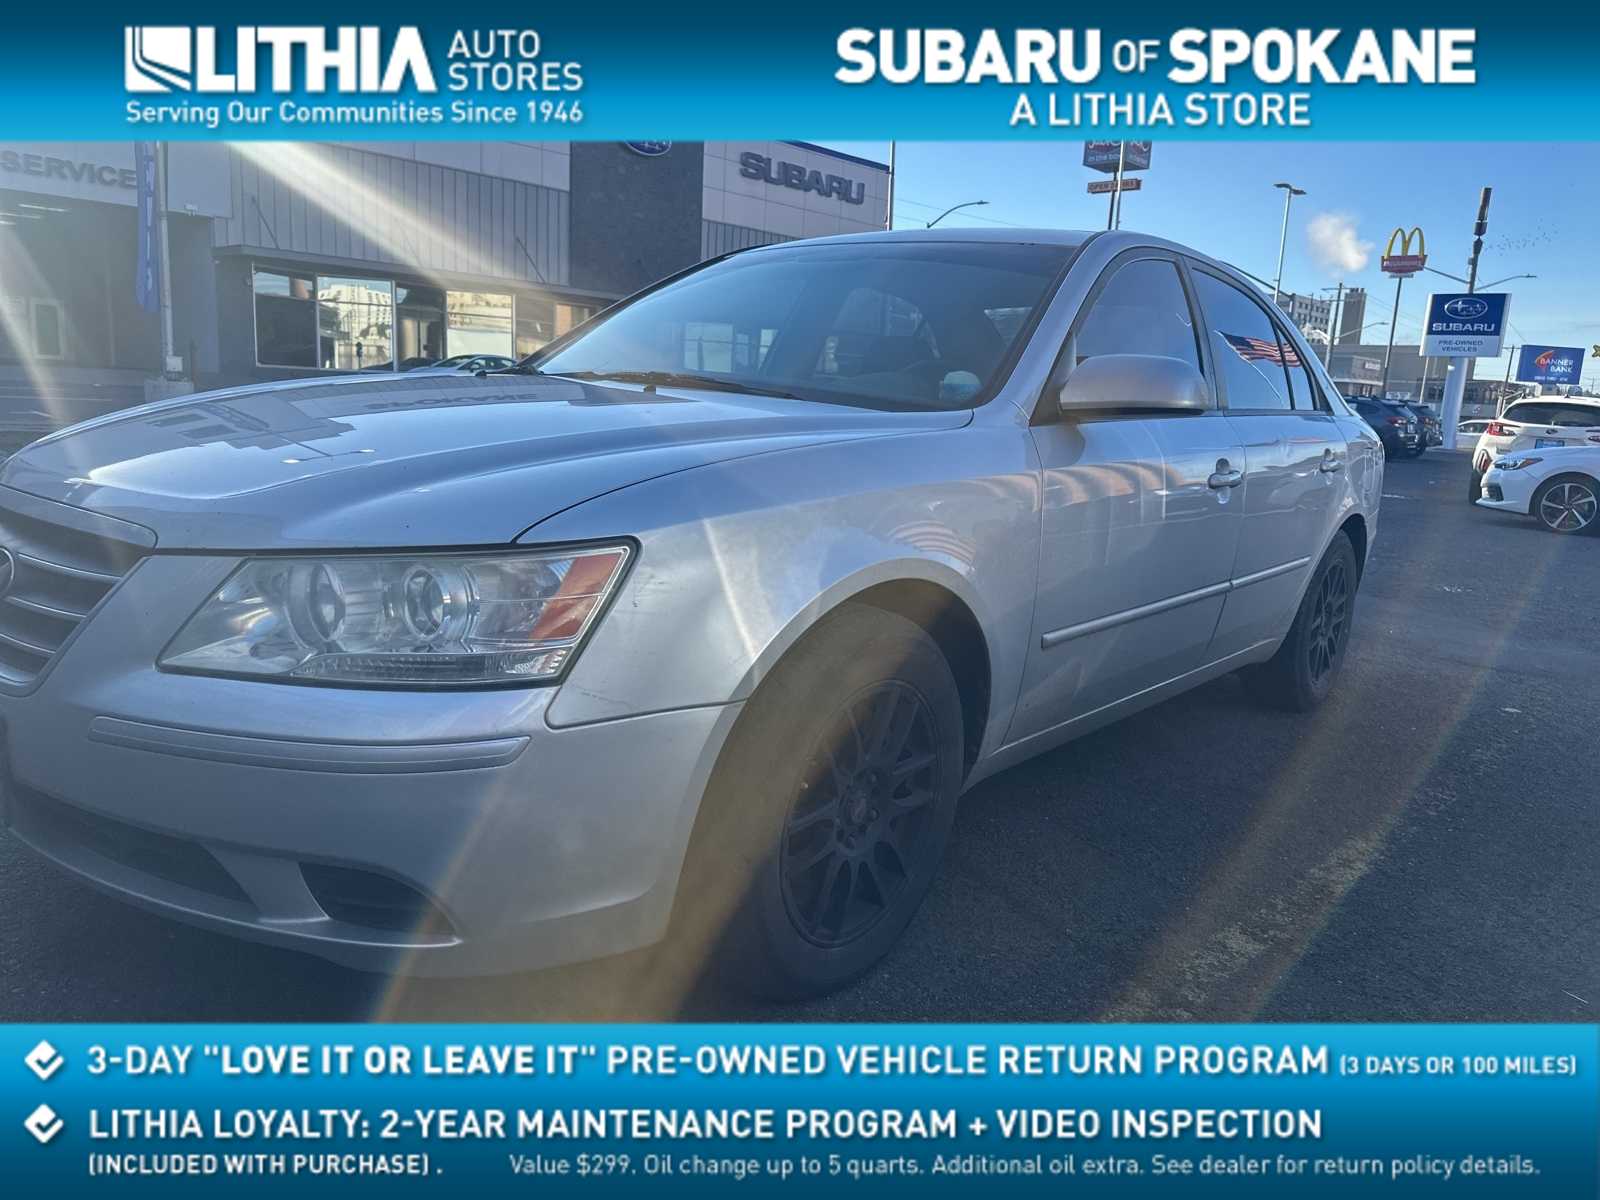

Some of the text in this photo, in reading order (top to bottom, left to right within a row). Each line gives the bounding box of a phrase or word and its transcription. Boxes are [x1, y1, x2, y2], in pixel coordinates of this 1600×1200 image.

[0, 150, 137, 190] SERVICE
[739, 151, 866, 206] SUBARU
[1431, 322, 1496, 332] SUBARU
[1540, 358, 1574, 366] BANNER
[1550, 365, 1573, 374] BANK
